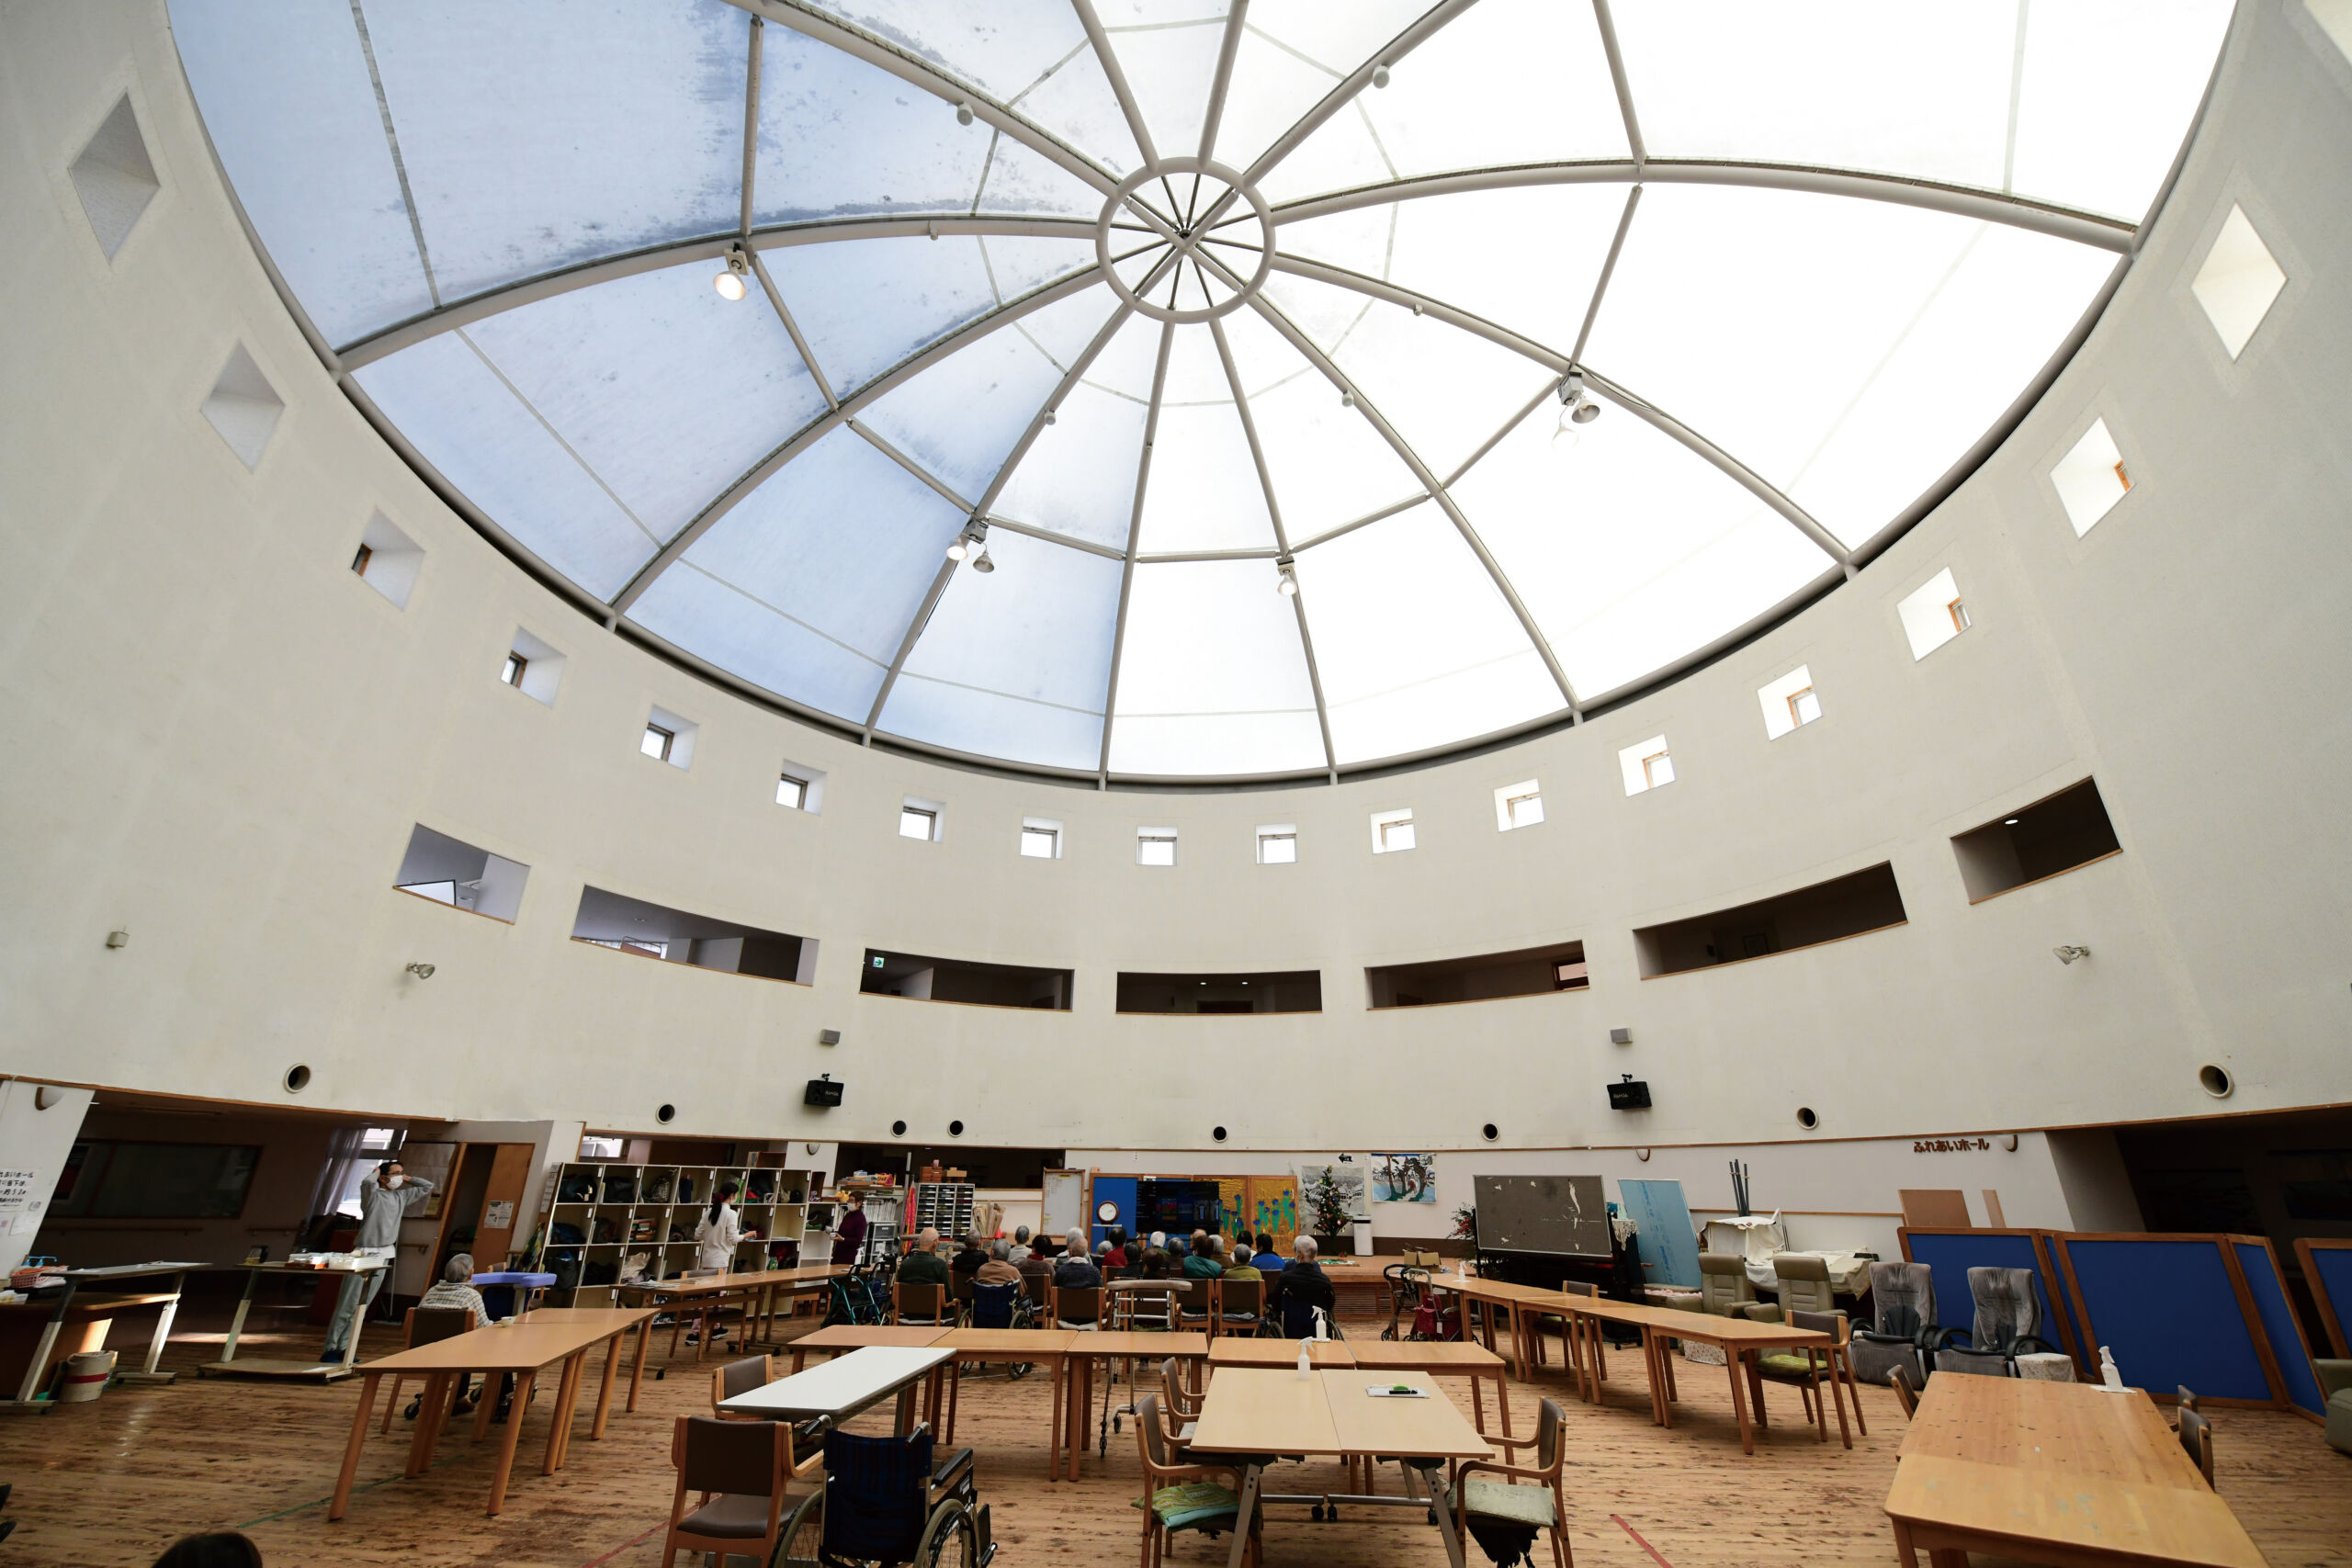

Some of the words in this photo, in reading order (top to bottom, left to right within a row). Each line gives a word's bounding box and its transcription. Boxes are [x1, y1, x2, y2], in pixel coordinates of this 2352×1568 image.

[1913, 1138, 1990, 1154] ふれあいホール
